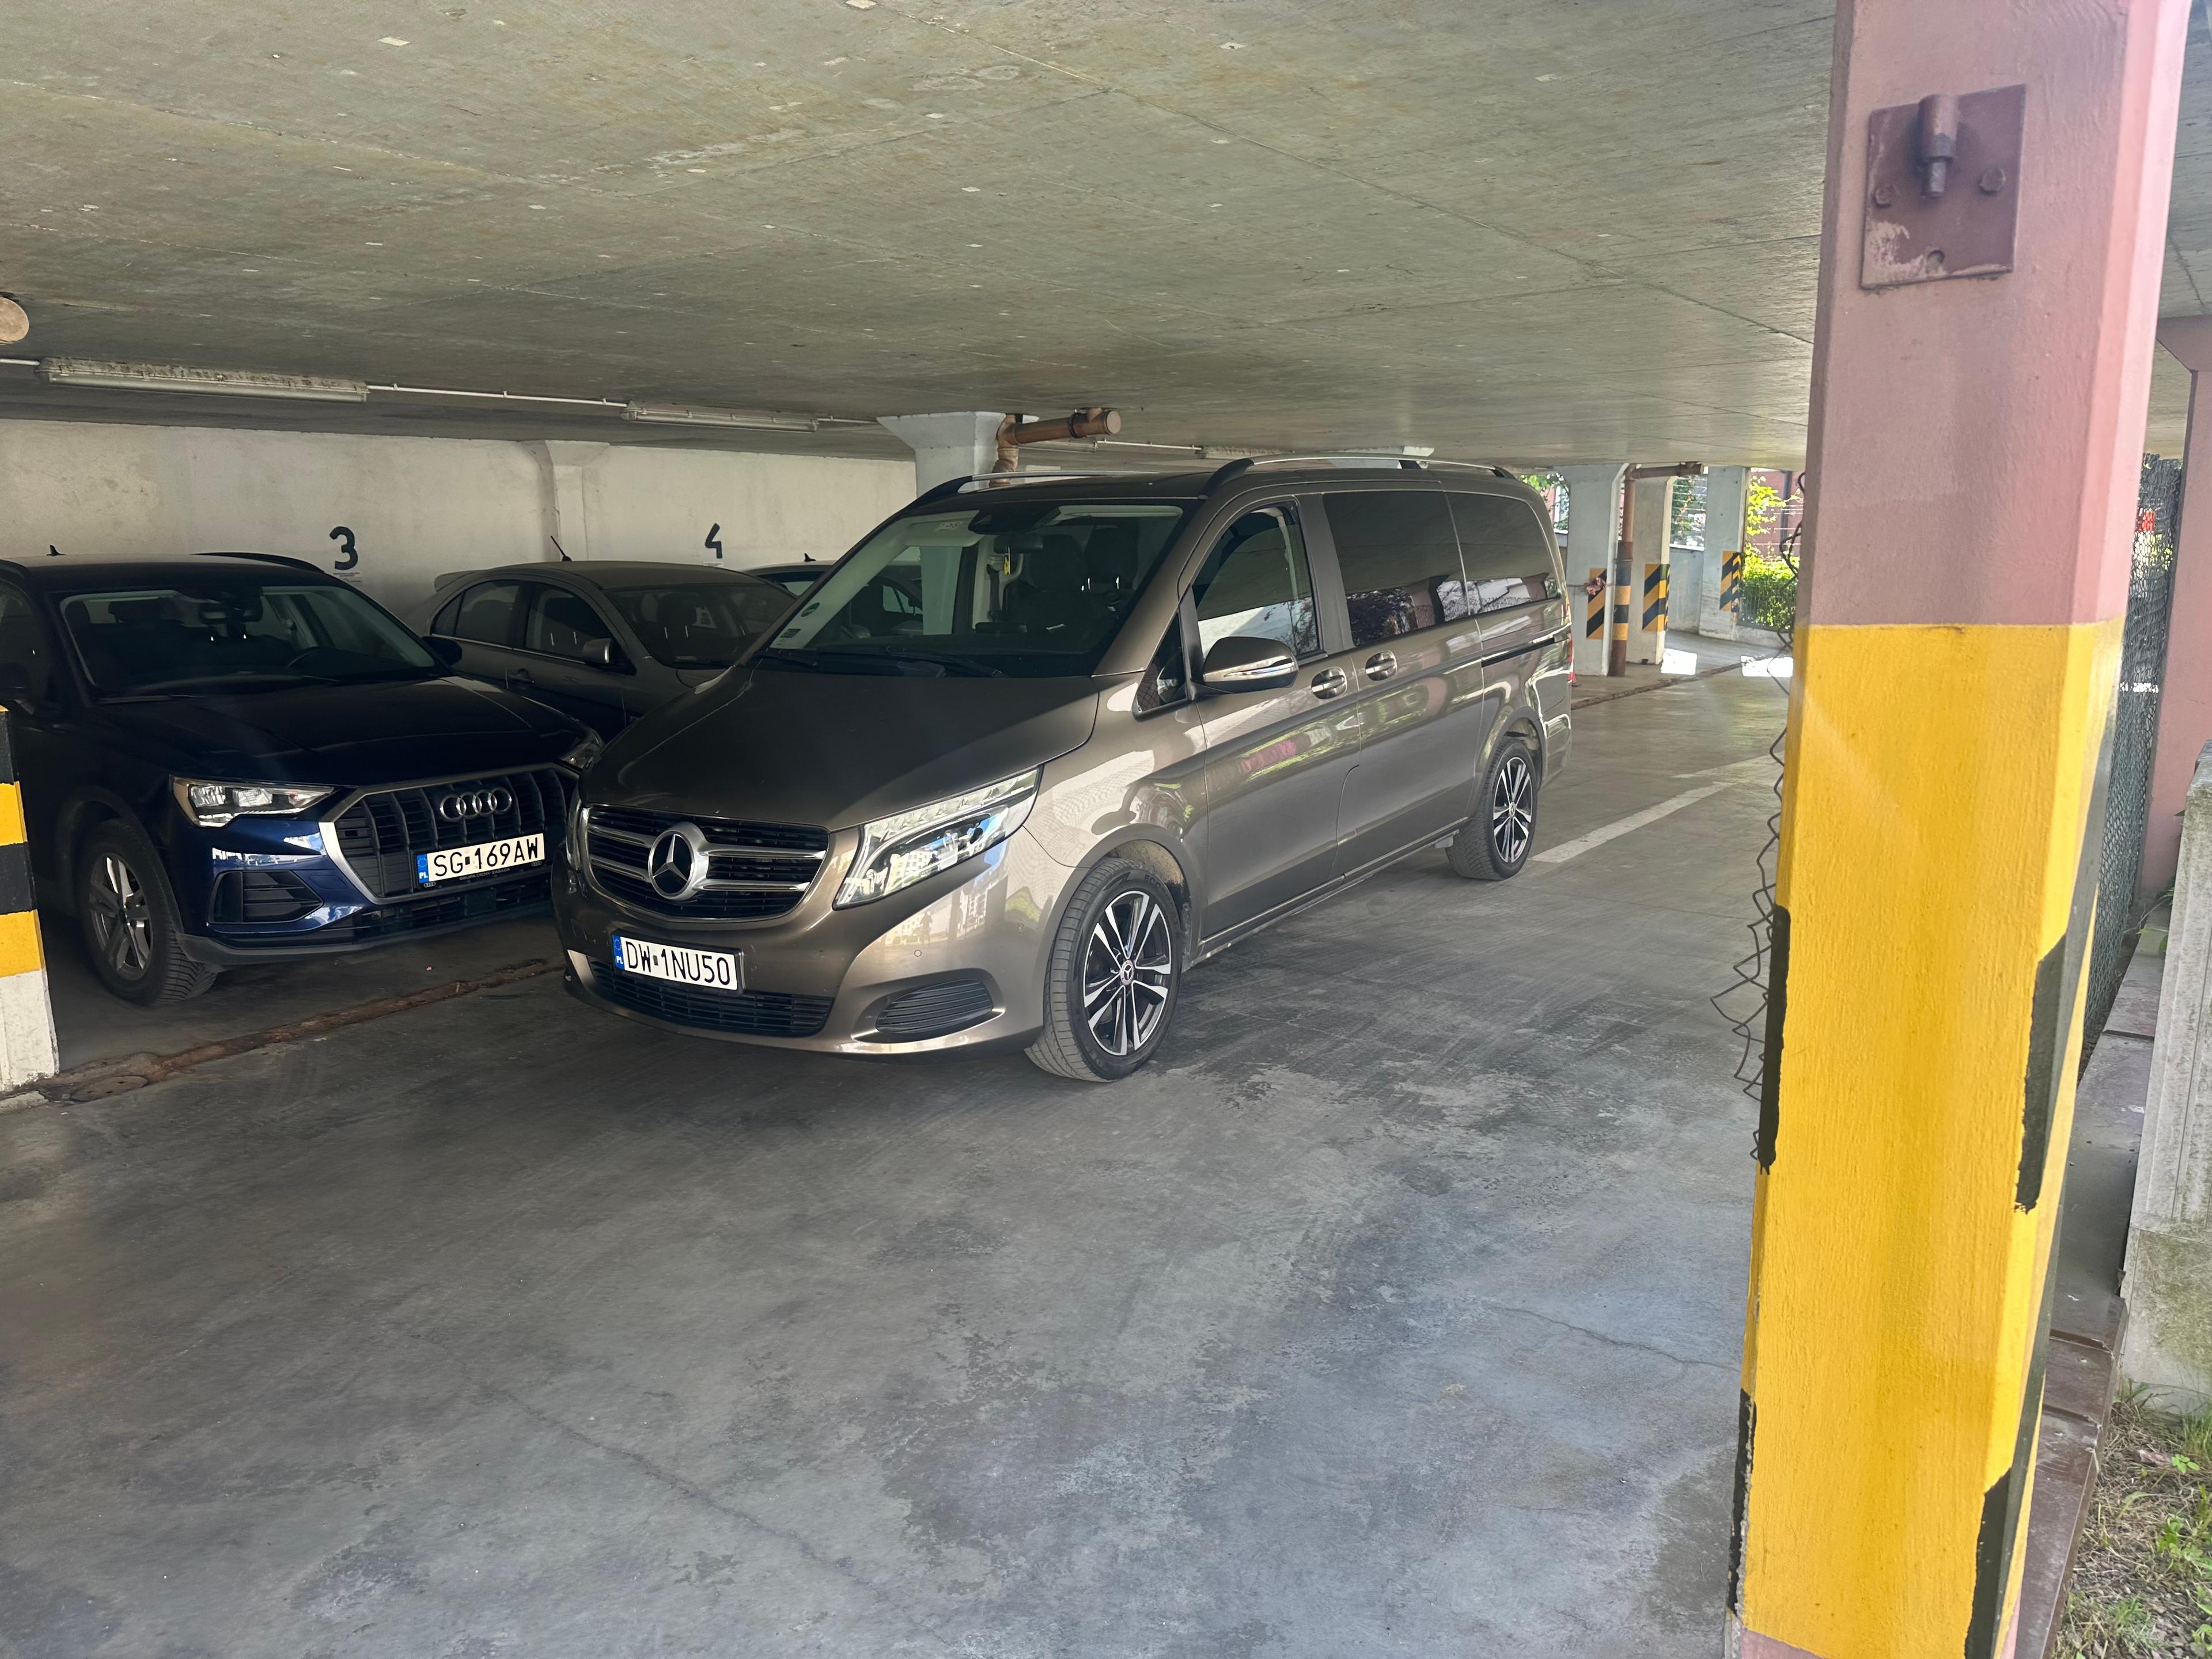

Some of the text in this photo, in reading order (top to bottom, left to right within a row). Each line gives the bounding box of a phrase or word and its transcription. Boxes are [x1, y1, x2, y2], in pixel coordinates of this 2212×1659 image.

[329, 526, 358, 570] 3
[705, 522, 722, 559] 4
[419, 871, 428, 880] PL
[616, 955, 624, 965] PL
